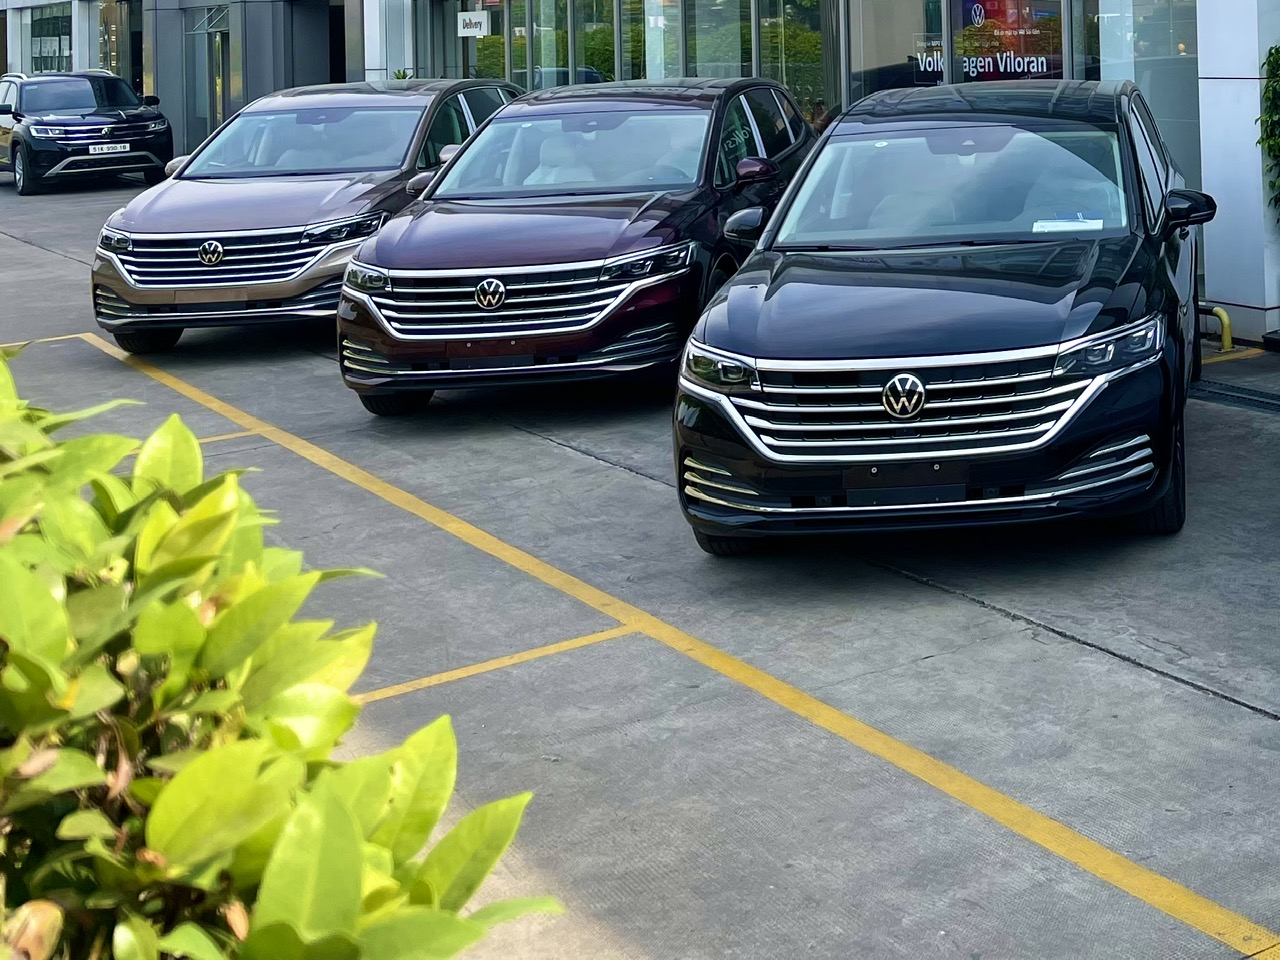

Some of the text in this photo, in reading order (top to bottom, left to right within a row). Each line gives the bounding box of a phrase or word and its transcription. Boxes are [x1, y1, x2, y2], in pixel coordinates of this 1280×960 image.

[462, 17, 483, 32] Delivery
[917, 50, 1047, 77] Volkagen Viloran
